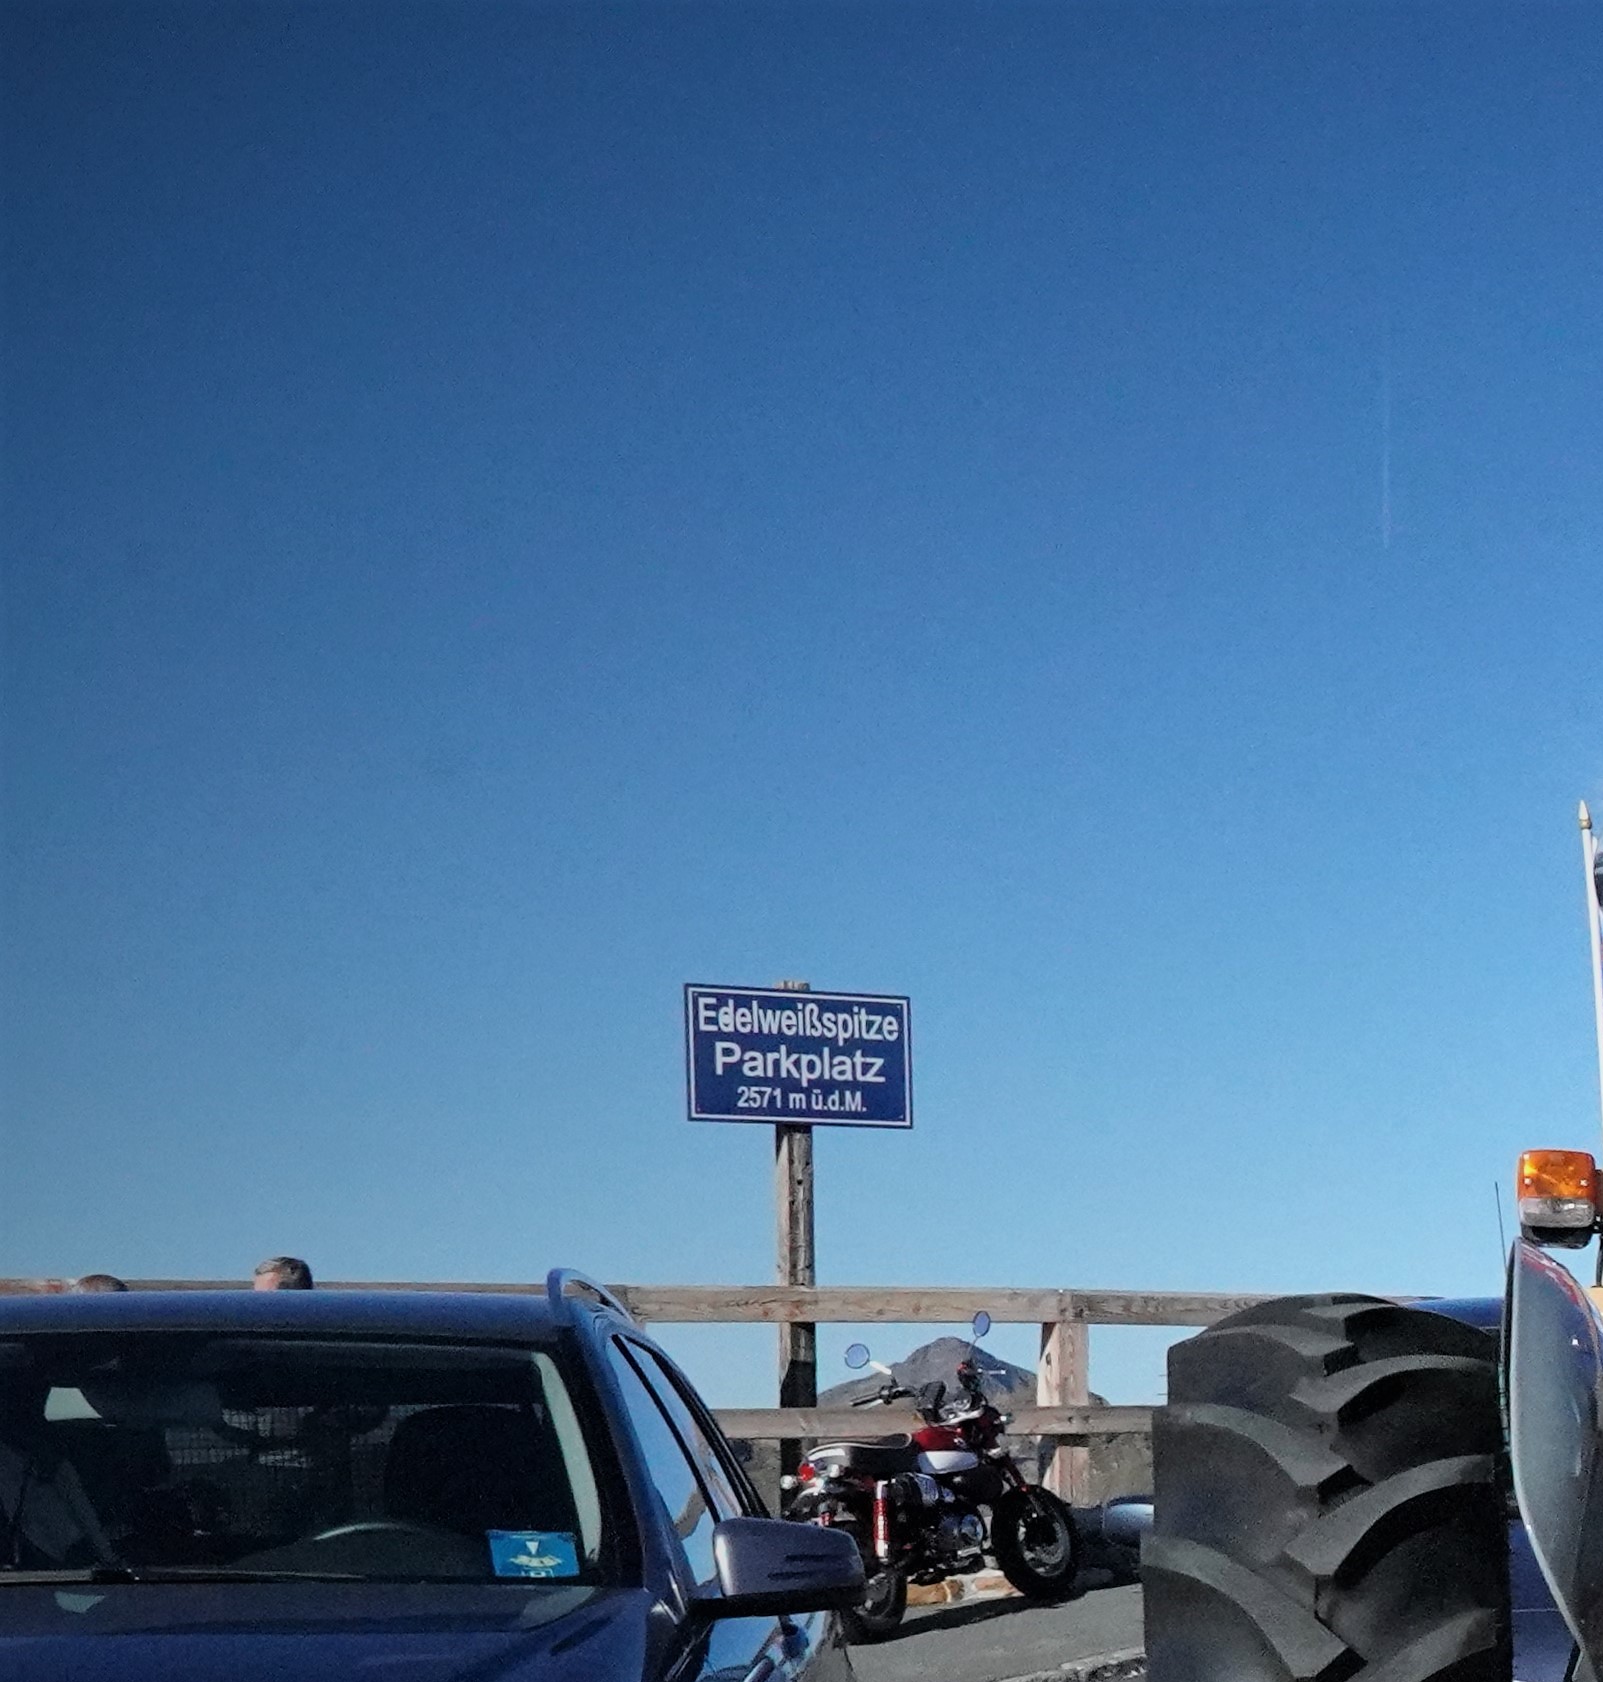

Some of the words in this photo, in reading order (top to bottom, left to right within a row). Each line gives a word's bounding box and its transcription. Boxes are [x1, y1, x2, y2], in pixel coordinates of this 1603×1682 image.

[698, 997, 899, 1046] Edelweißspitze
[713, 1040, 886, 1086] Parkplatz
[736, 1086, 783, 1109] 2571
[788, 1095, 807, 1110] m
